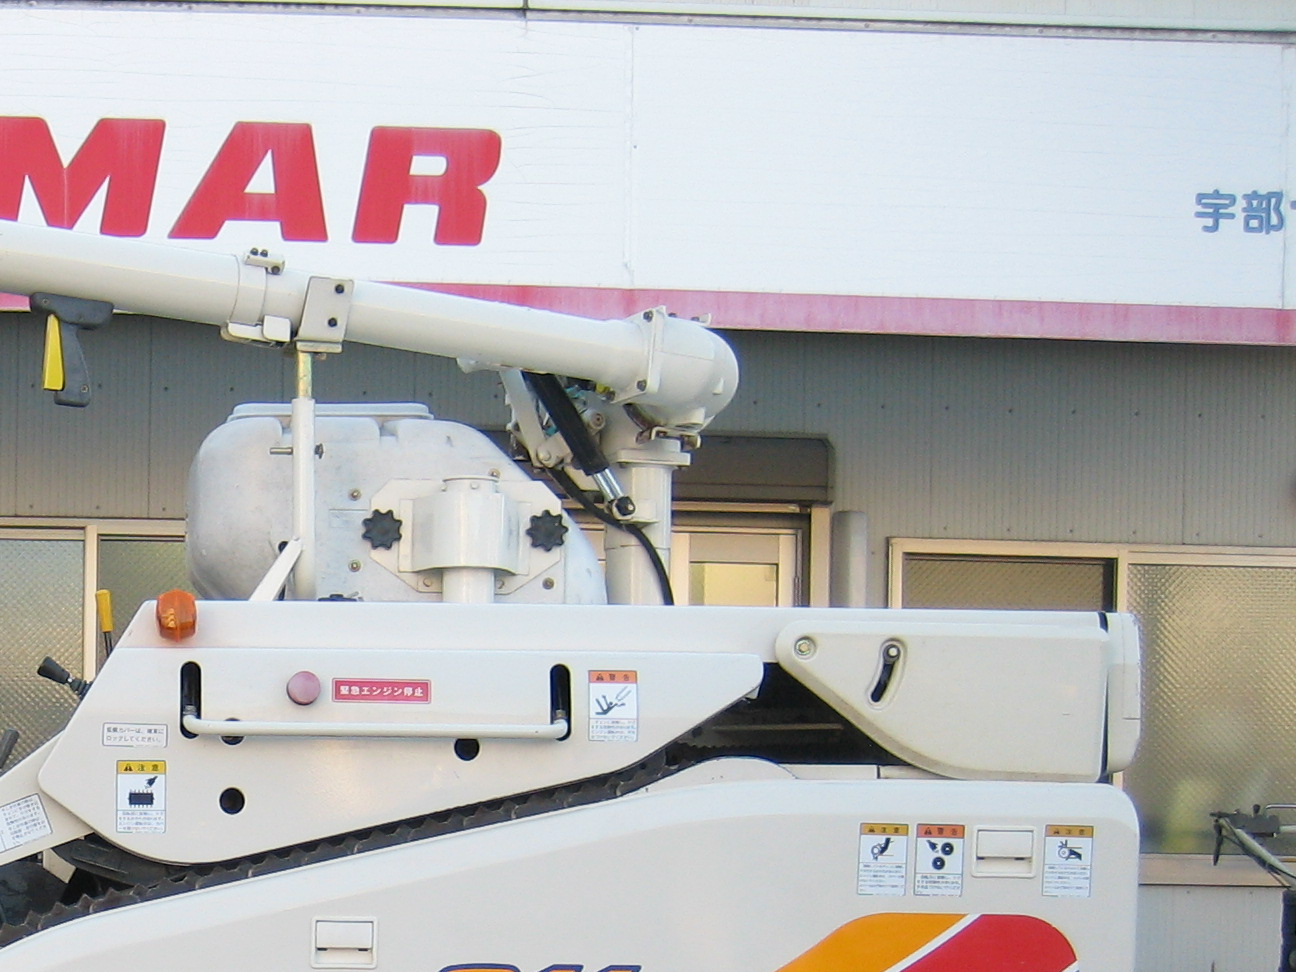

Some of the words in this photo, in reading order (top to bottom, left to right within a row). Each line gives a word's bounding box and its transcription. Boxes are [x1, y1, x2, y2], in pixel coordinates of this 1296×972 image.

[1193, 188, 1296, 235] 宇部
[339, 685, 424, 697] 緊急エンジン停止
